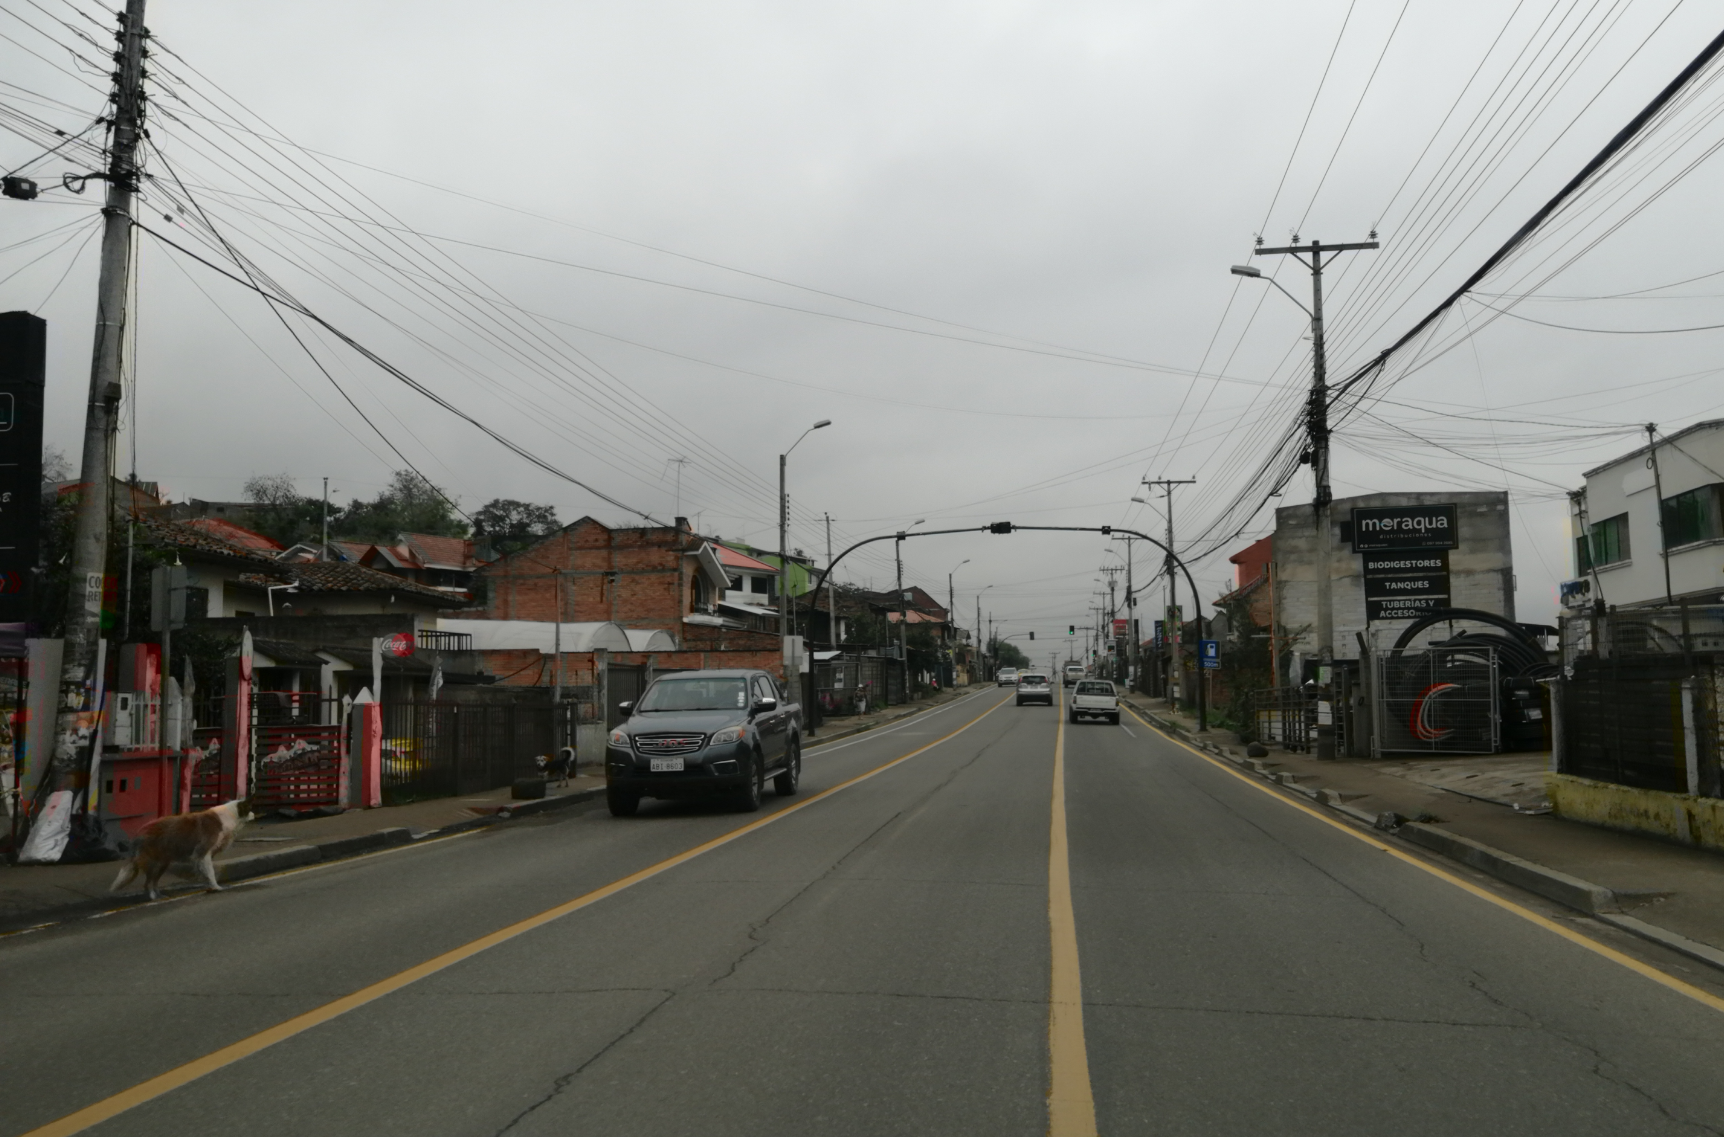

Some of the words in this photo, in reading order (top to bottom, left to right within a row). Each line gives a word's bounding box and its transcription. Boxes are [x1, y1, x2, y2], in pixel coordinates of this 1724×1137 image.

[1362, 516, 1448, 533] meraqua
[1368, 559, 1442, 569] BIODIGESTORES
[1384, 580, 1430, 590] TANQUES
[1381, 598, 1426, 609] TUBERÍAS
[1428, 599, 1435, 607] Y
